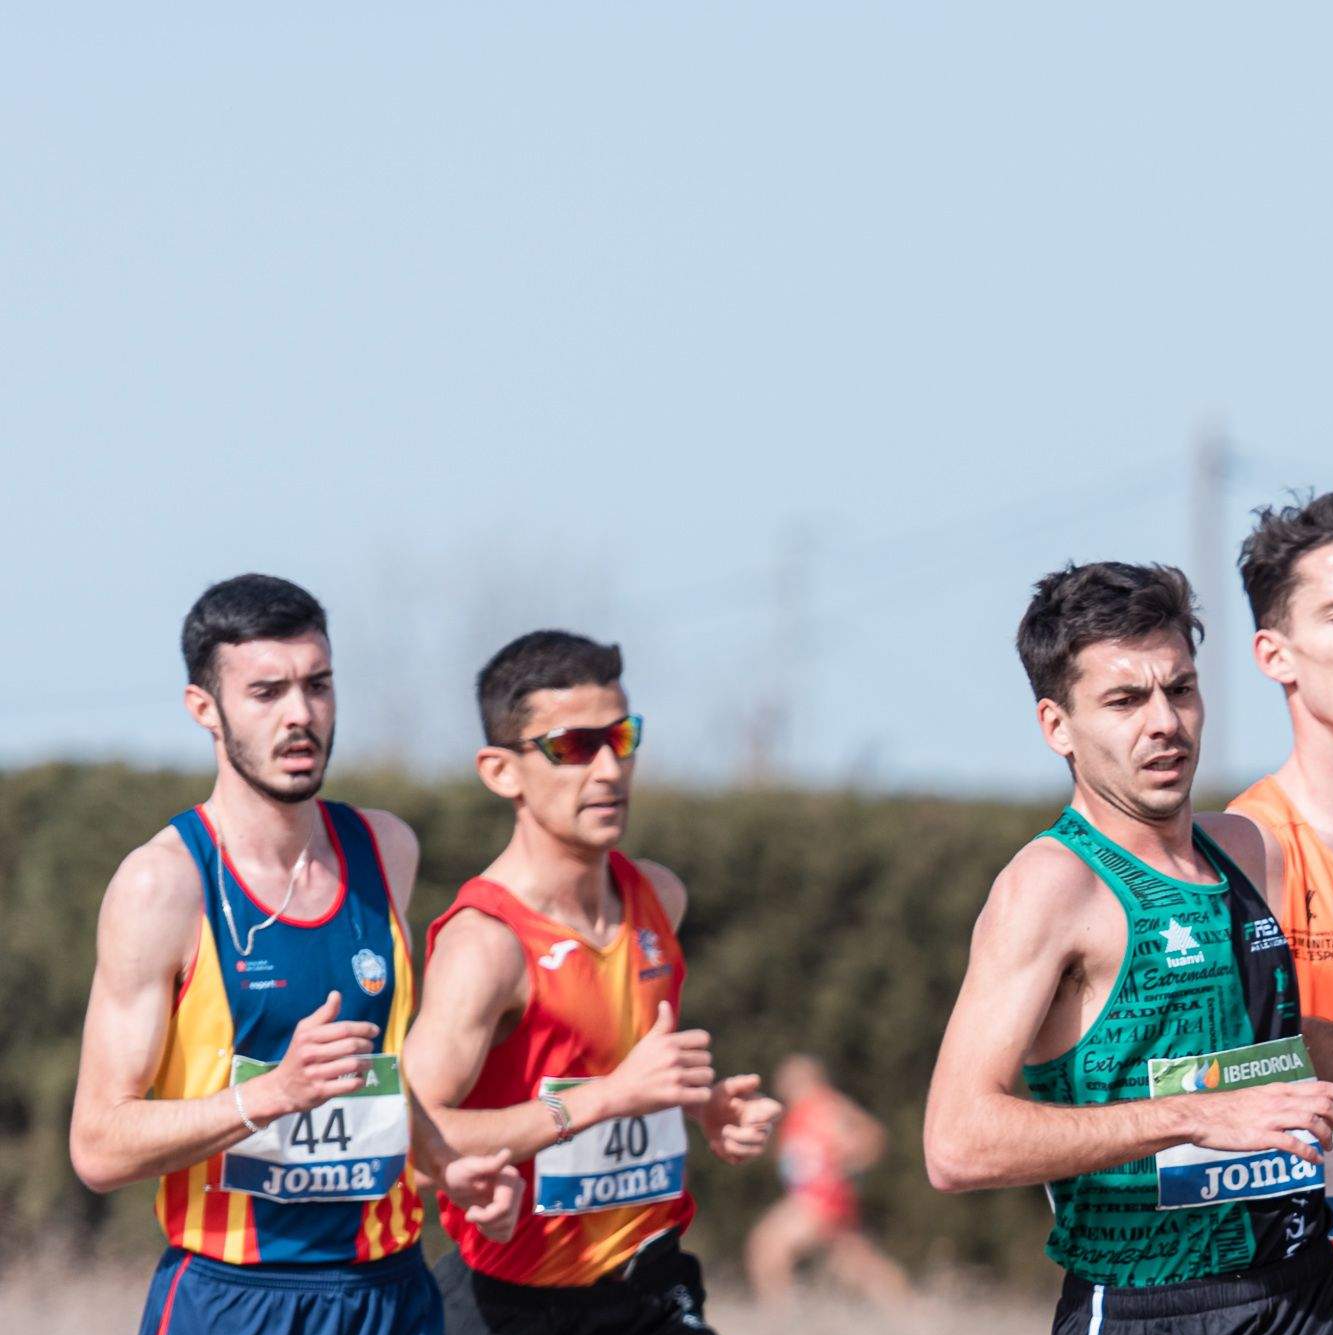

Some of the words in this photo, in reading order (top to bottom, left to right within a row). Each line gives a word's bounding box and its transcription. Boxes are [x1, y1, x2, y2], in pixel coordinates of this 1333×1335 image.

[1166, 950, 1205, 969] luanvi
[1223, 1052, 1304, 1084] IBERDROLA
[290, 1107, 352, 1154] 44
[604, 1115, 649, 1162] 40
